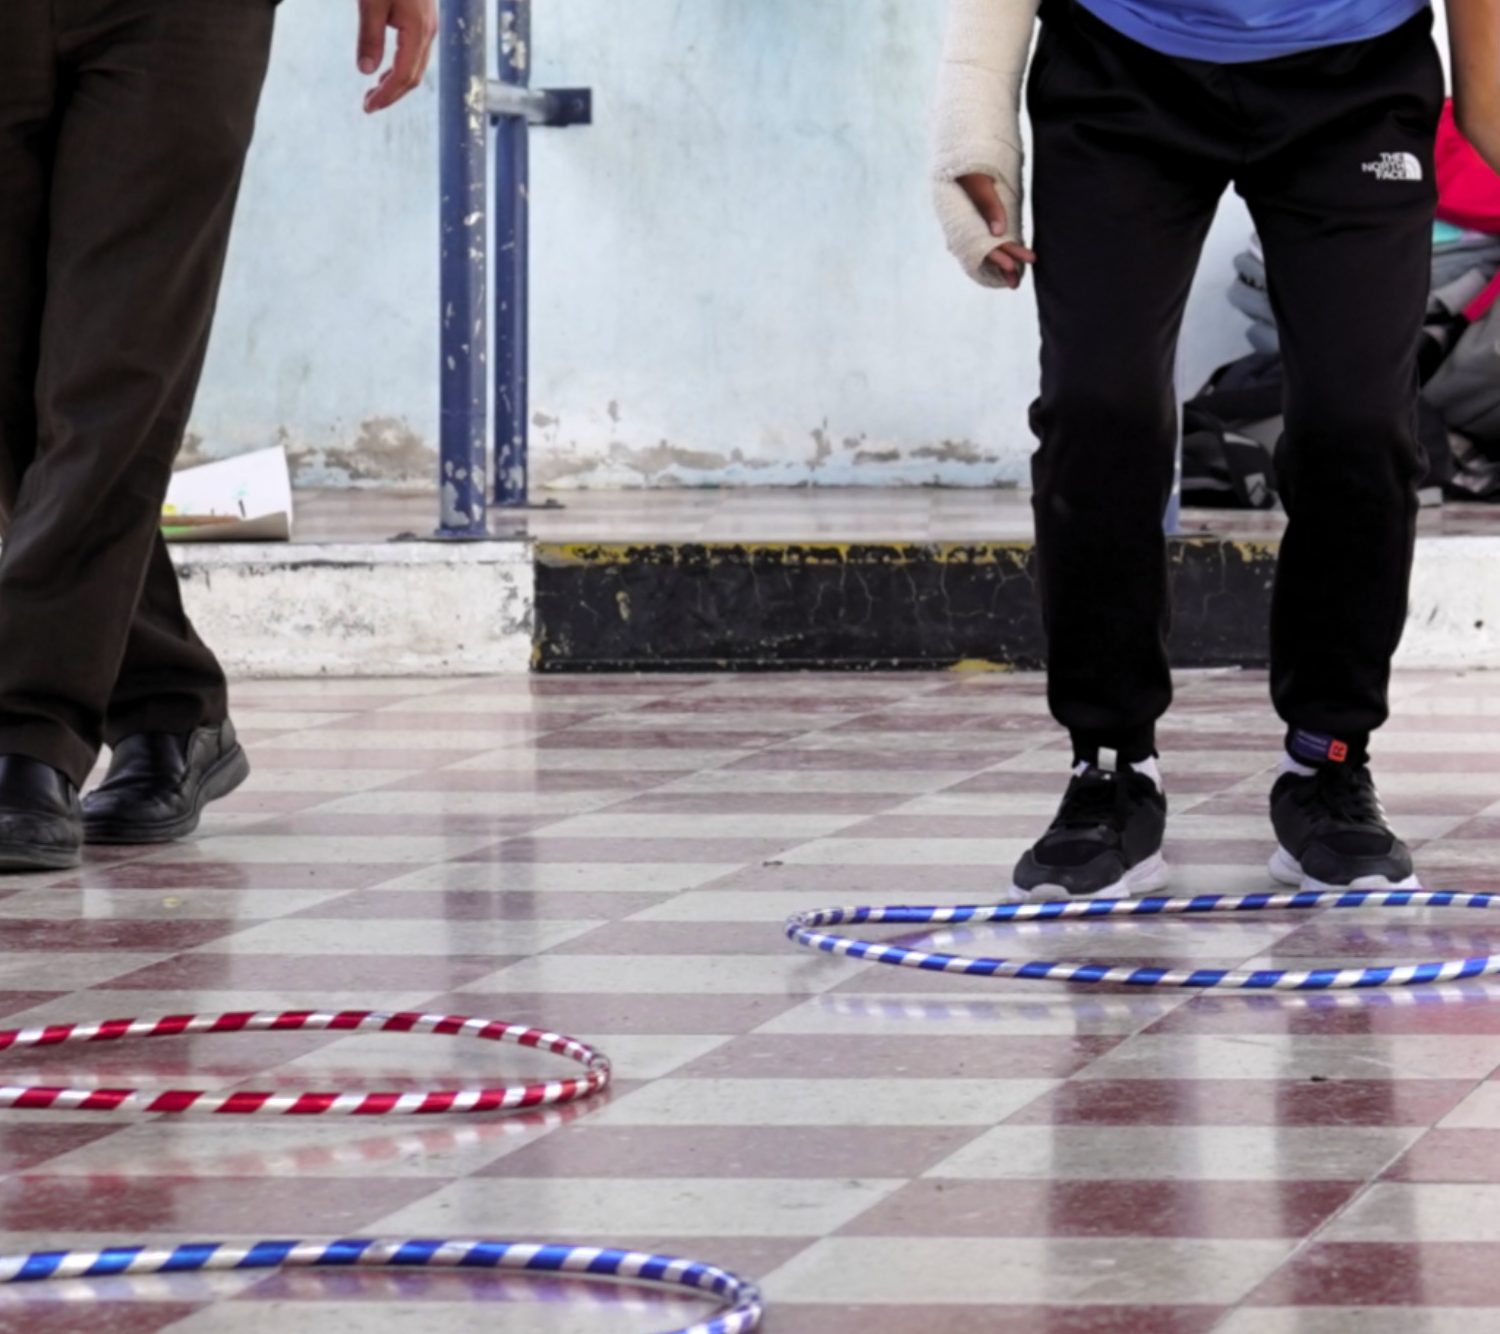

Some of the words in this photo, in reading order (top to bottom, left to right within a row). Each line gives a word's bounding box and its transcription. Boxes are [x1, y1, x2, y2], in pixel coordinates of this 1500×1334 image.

[1379, 152, 1403, 163] THE
[1361, 161, 1405, 172] NORTH
[1375, 170, 1405, 181] FACE
